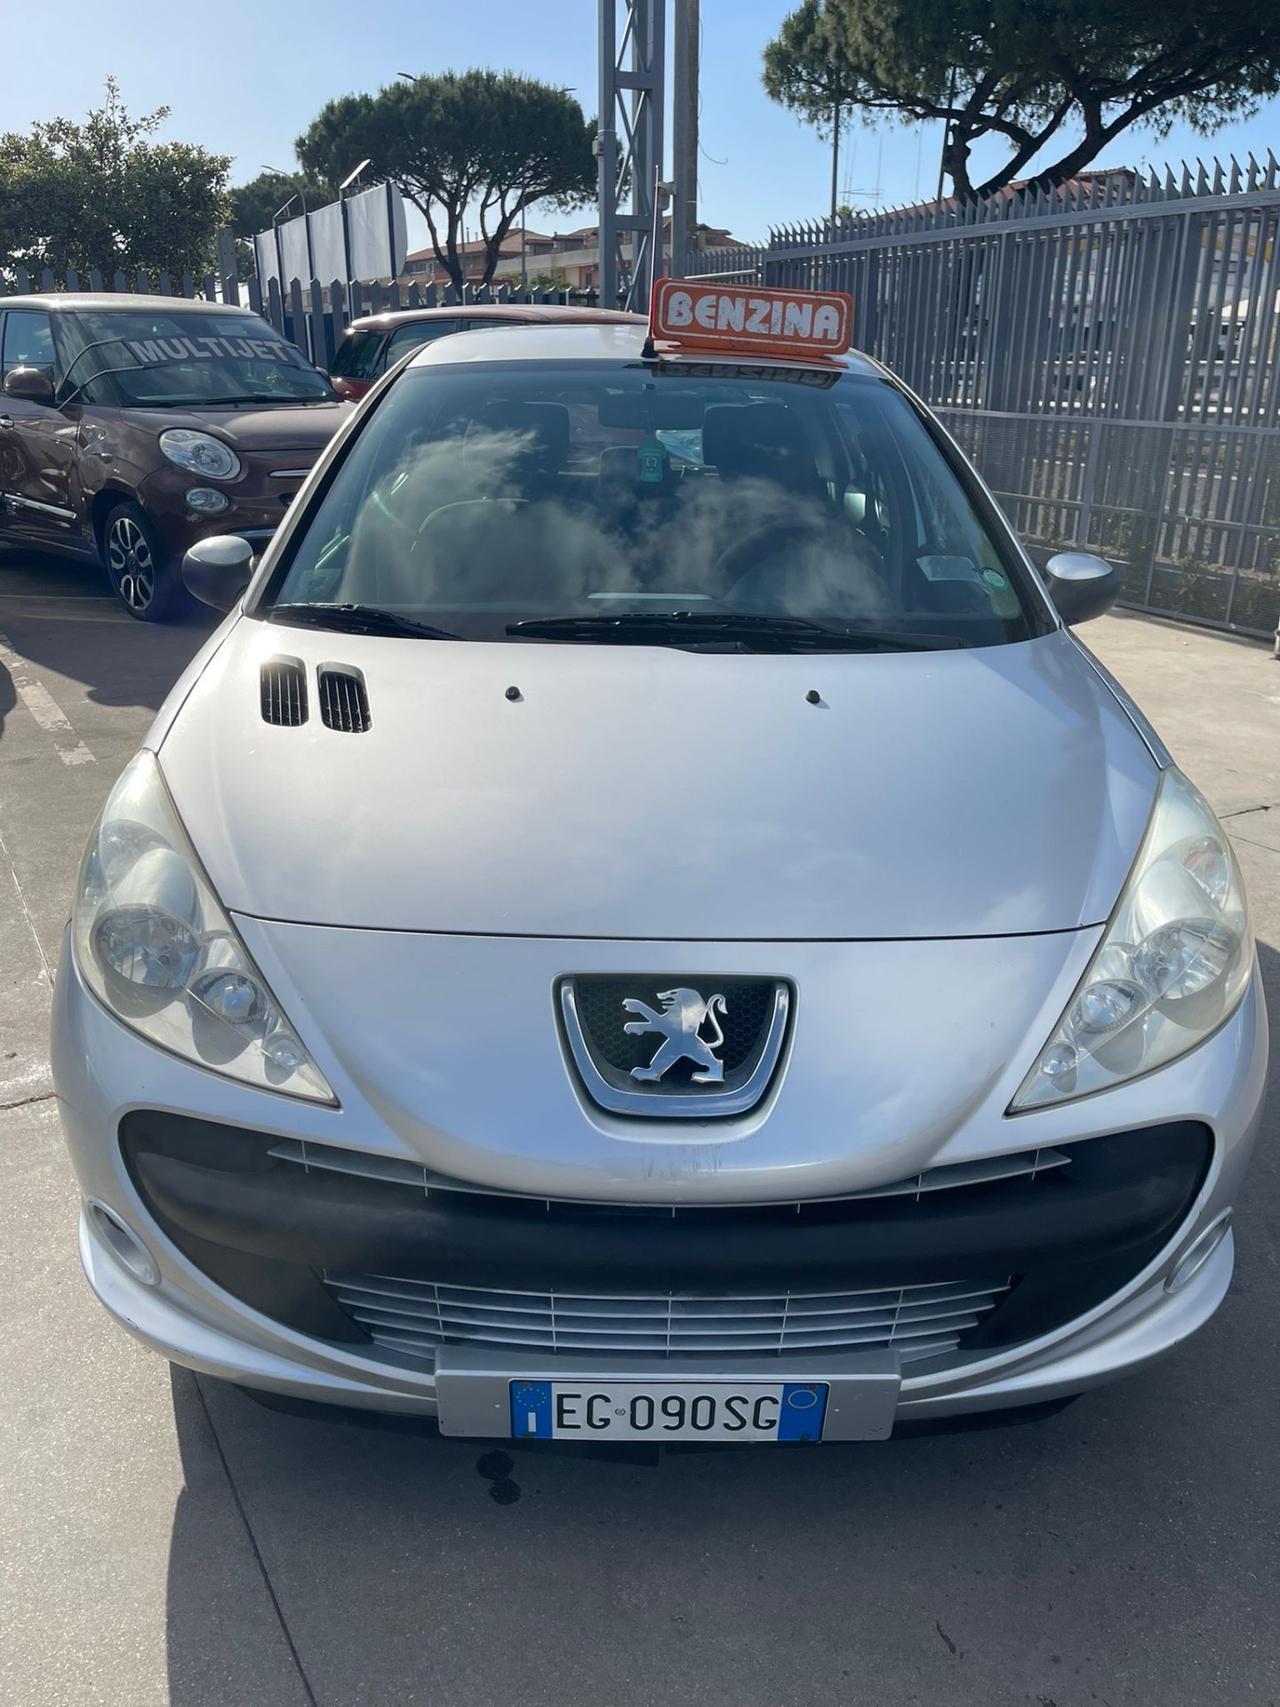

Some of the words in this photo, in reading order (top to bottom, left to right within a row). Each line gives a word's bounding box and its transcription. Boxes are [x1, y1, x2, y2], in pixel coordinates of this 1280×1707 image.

[667, 291, 840, 341] BENZINA
[128, 336, 290, 363] MULTIJET
[556, 1393, 612, 1430] EG
[629, 1394, 780, 1432] 090SG
